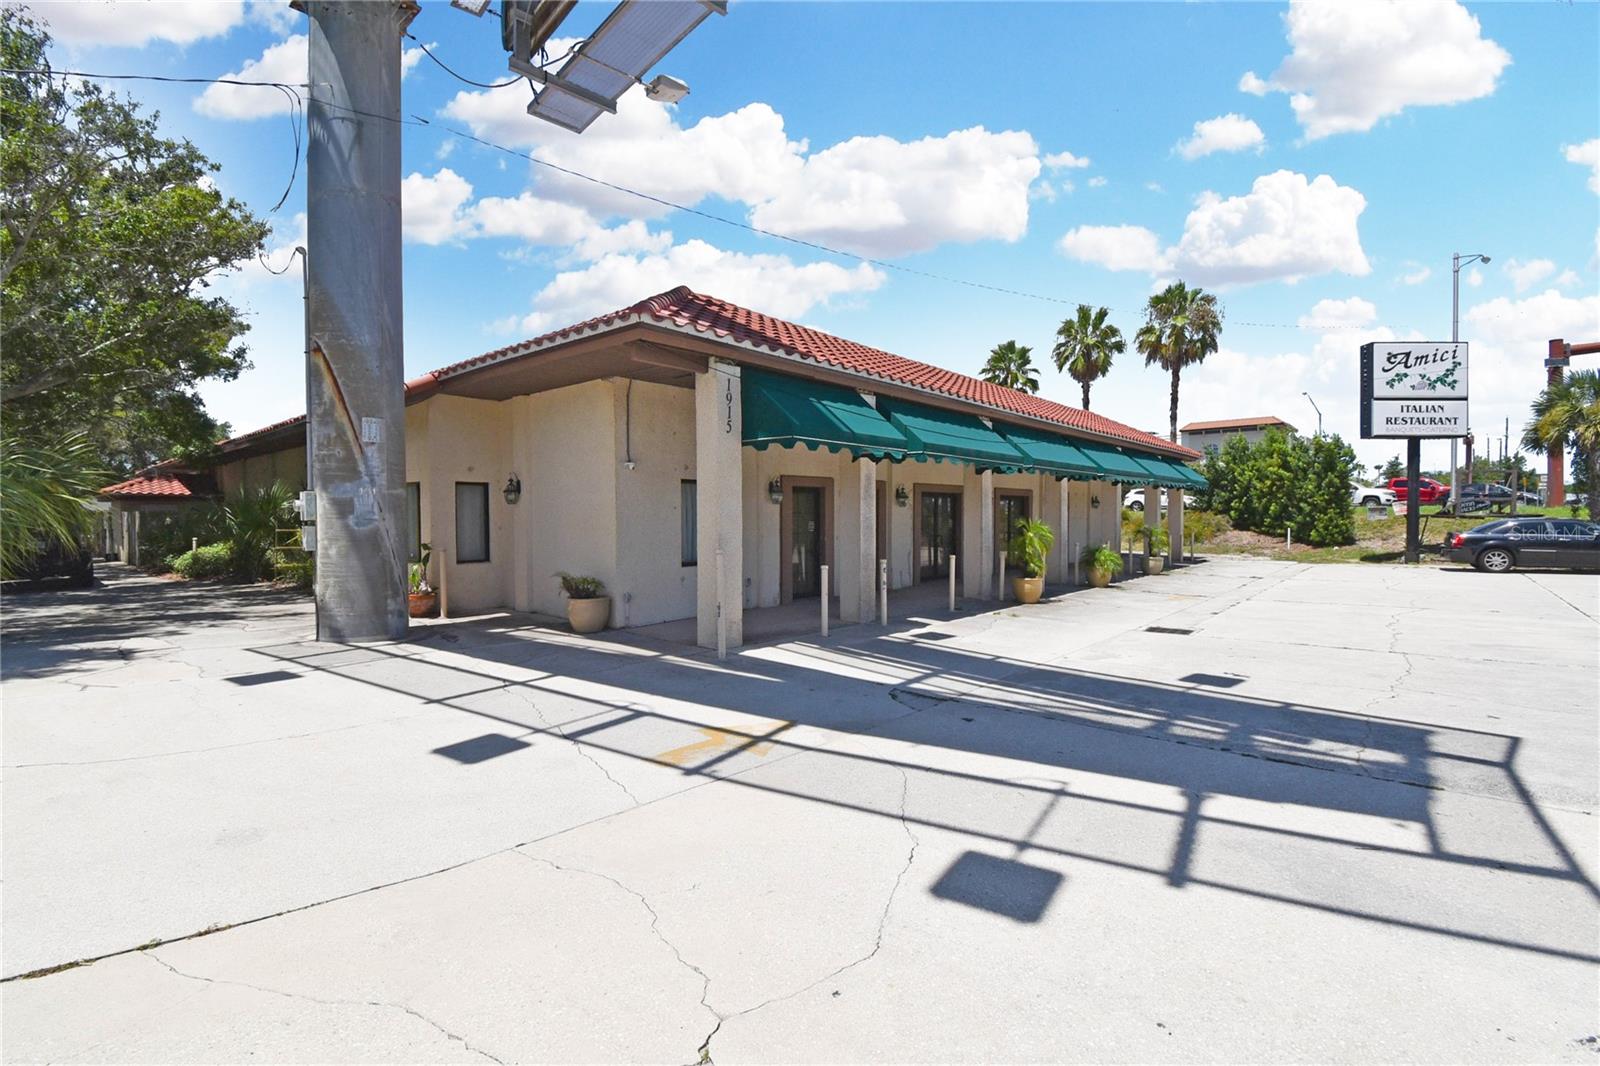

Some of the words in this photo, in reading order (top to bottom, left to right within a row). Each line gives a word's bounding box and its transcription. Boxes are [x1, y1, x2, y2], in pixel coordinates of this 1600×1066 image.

[1381, 345, 1459, 373] Amici
[725, 378, 733, 434] 1915
[1400, 404, 1445, 413] ITALIAN
[1385, 417, 1459, 426] RESTAURANT
